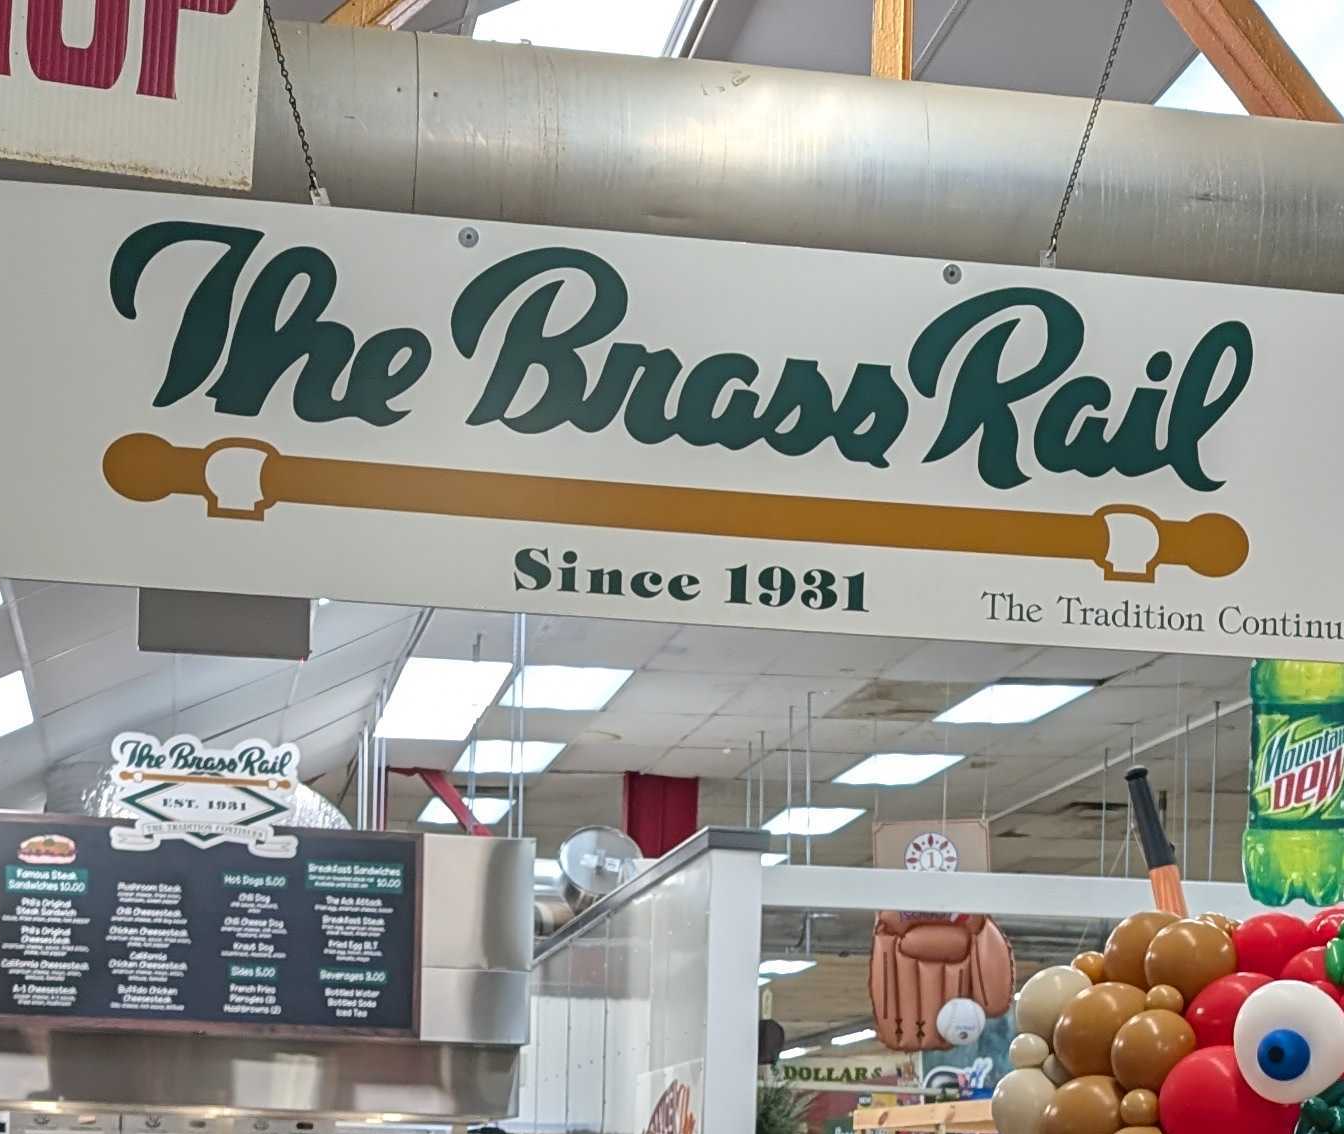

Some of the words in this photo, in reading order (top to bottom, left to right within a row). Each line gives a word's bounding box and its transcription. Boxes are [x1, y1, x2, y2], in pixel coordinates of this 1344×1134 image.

[110, 222, 431, 426] The
[449, 247, 909, 469] Brass
[907, 287, 1254, 492] Rail
[513, 547, 701, 601] Since
[725, 564, 869, 613] 1931
[981, 591, 1043, 623] The
[1057, 596, 1205, 632] Tradition
[120, 740, 166, 769] The
[169, 742, 238, 773] Brass
[238, 747, 293, 777] Rail
[162, 798, 199, 809] EST.
[208, 800, 247, 811] 1931
[8, 879, 59, 891] Sandwiches
[16, 868, 50, 879] Famous
[51, 869, 78, 880] Steak
